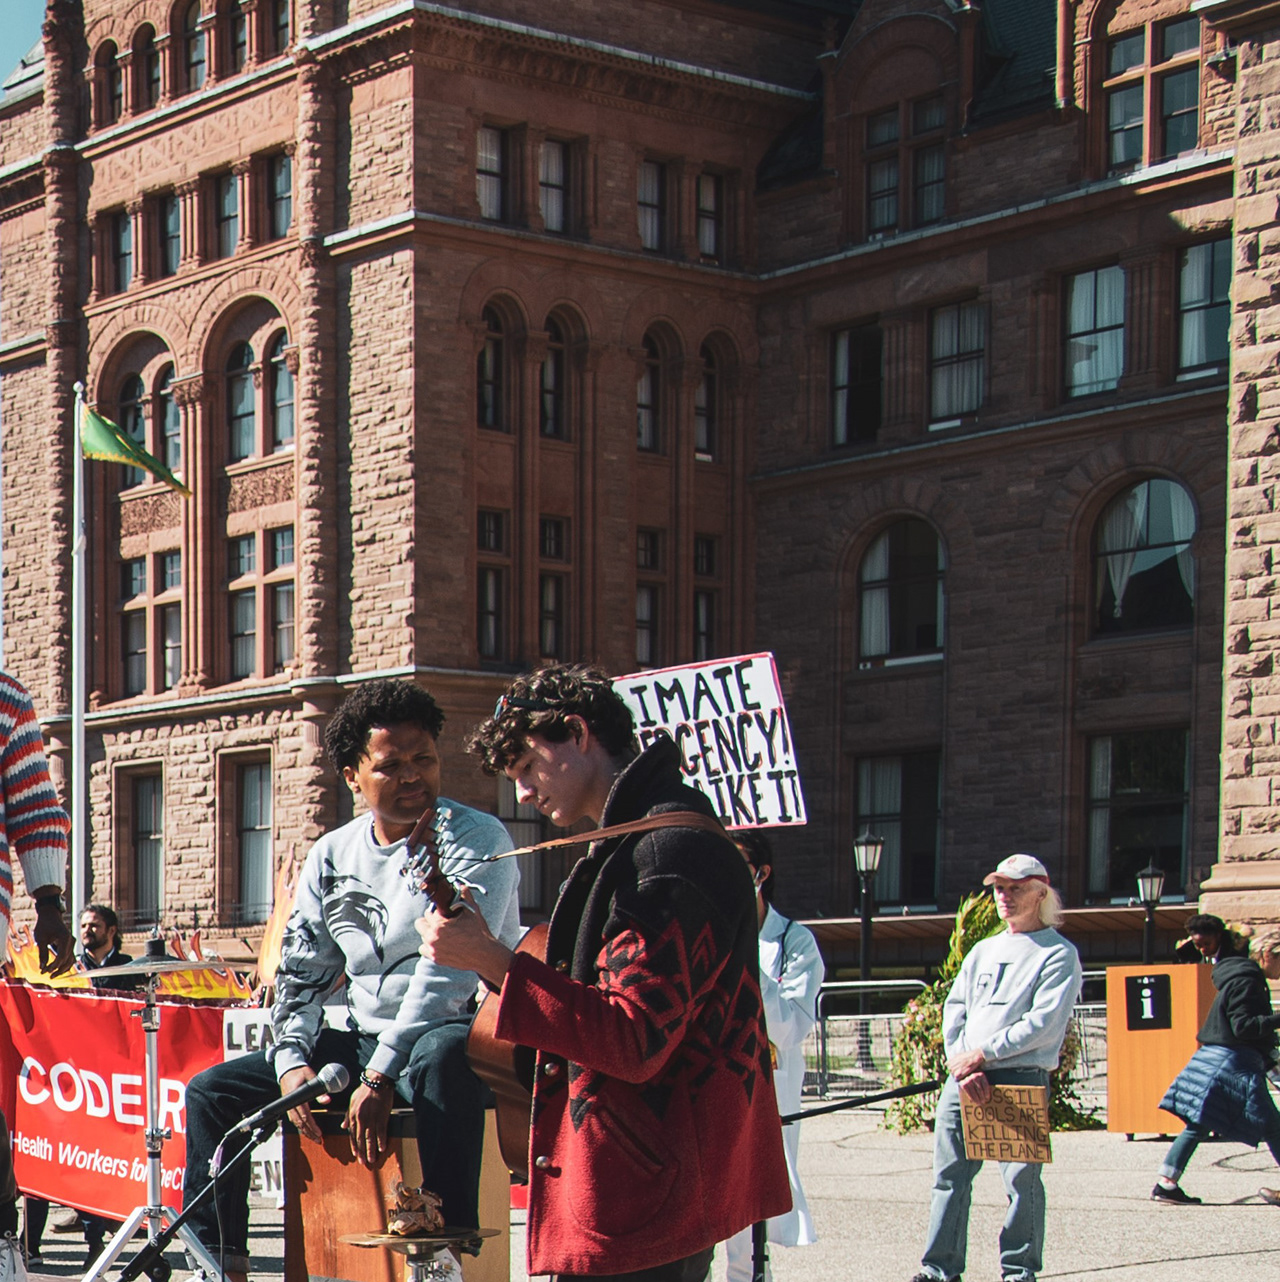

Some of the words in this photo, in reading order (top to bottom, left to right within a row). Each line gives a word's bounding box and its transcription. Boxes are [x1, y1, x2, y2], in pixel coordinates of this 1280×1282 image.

[19, 1056, 145, 1126] CODE
[964, 1105, 1015, 1123] FOOLS
[1020, 1107, 1045, 1124] ARE
[967, 1124, 1048, 1142] KILLING
[9, 1130, 53, 1162] Health
[58, 1142, 128, 1179] Workers
[968, 1141, 996, 1157] THE
[999, 1142, 1051, 1160] PLANET
